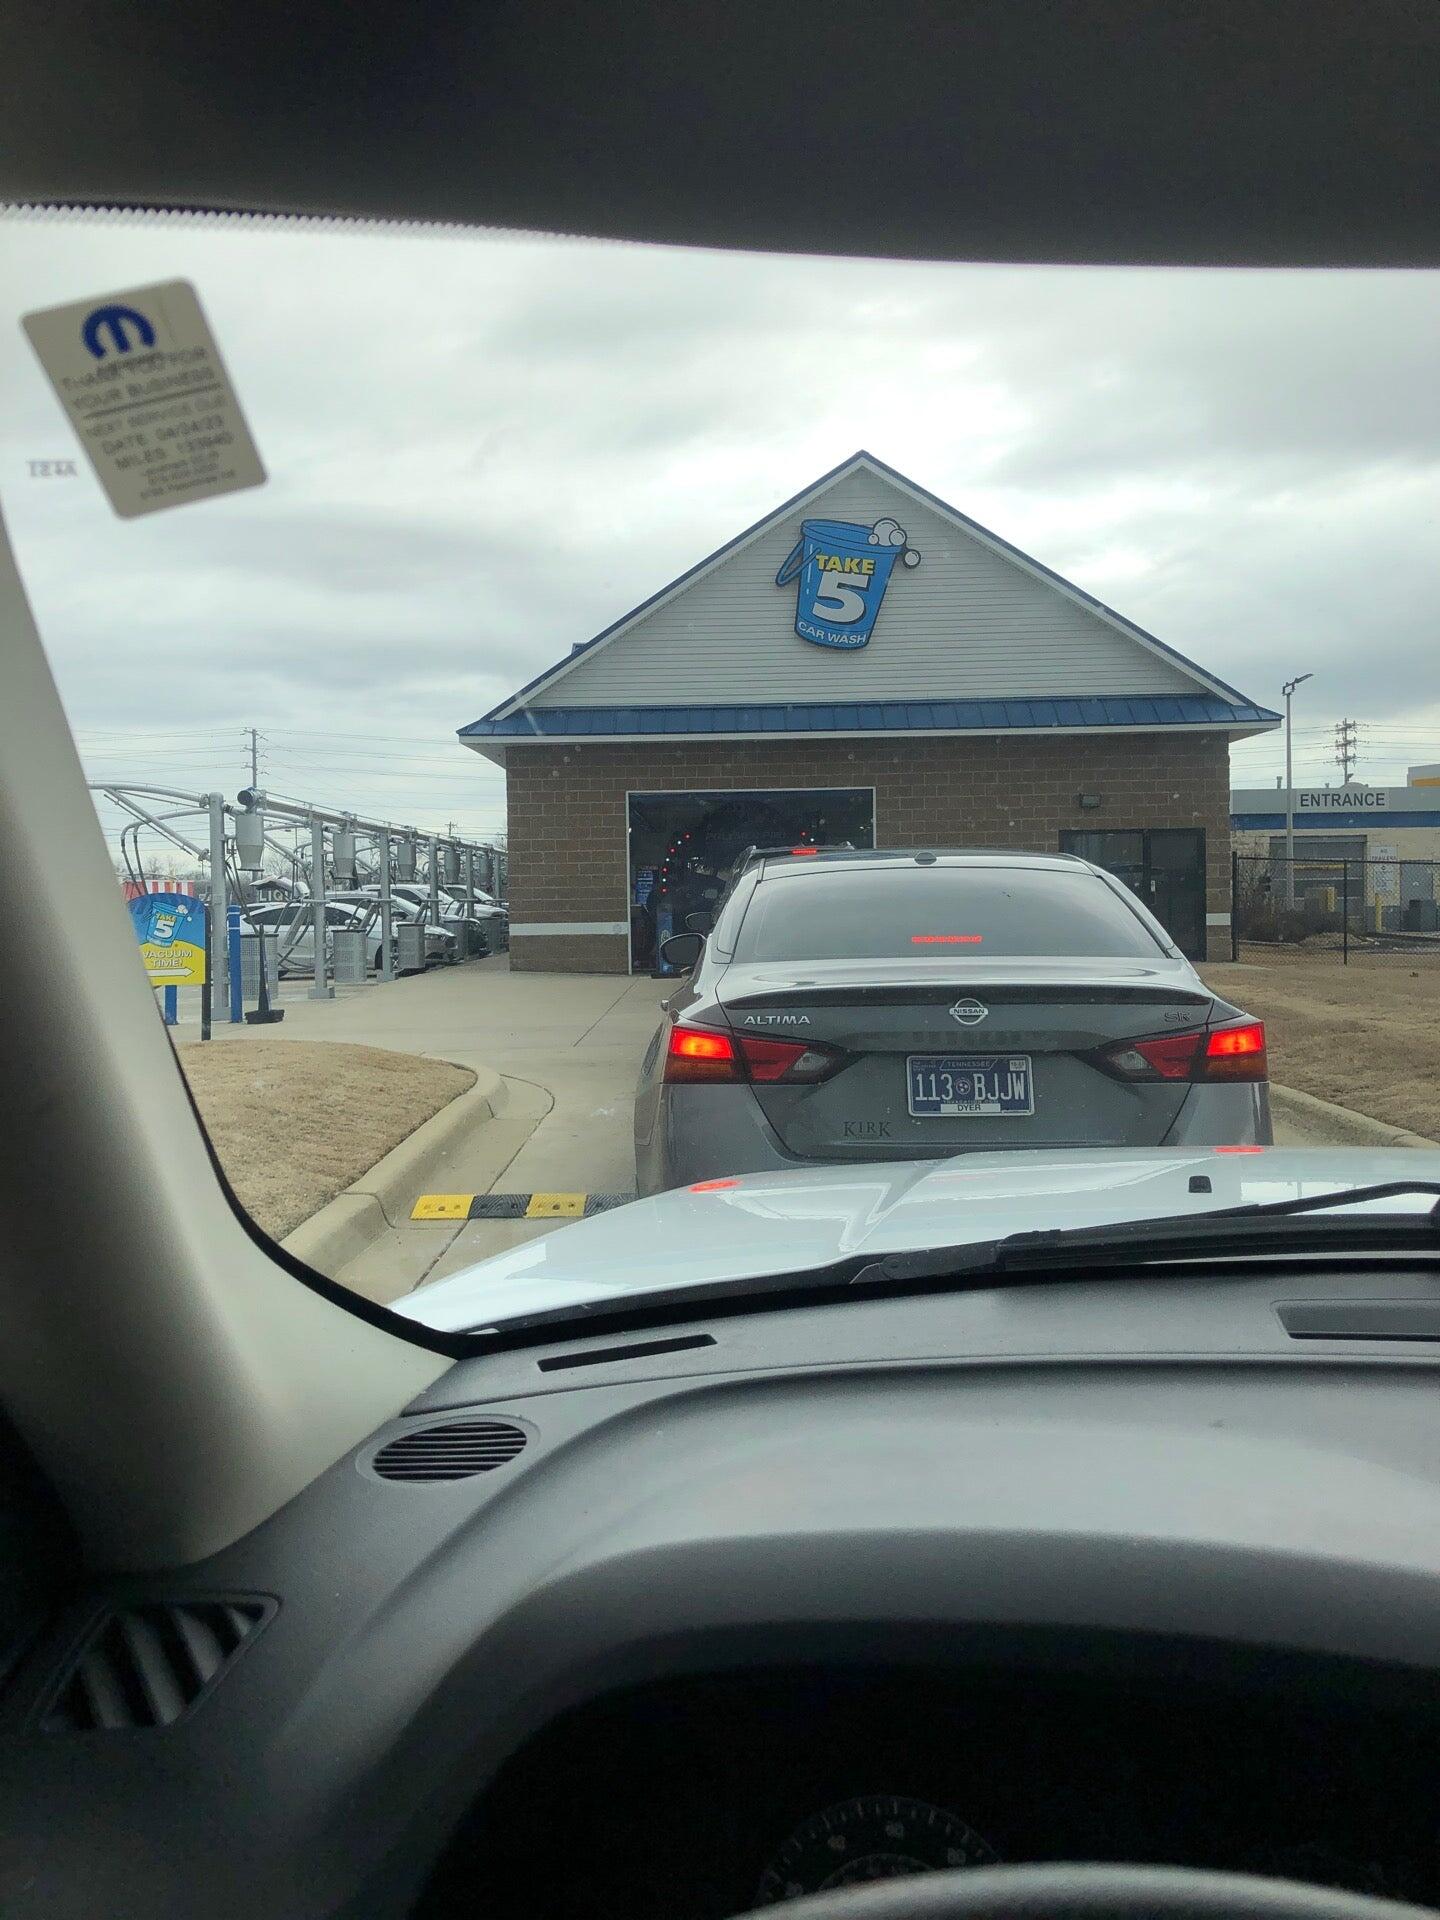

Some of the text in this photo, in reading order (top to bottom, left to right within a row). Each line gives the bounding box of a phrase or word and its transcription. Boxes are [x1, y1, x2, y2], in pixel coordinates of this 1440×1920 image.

[816, 554, 875, 575] TAKE
[812, 571, 870, 624] 5
[798, 621, 867, 644] CAR WASH
[1300, 791, 1386, 807] ENTRANCE
[156, 912, 178, 921] TAKE
[153, 919, 175, 938] 5
[143, 950, 193, 959] VACUUM
[744, 1015, 811, 1025] ALTIMA
[1164, 1011, 1191, 1022] SR
[915, 1072, 1025, 1101] 113 BJJW
[957, 1104, 982, 1112] DYER
[843, 1120, 892, 1137] KIRK
